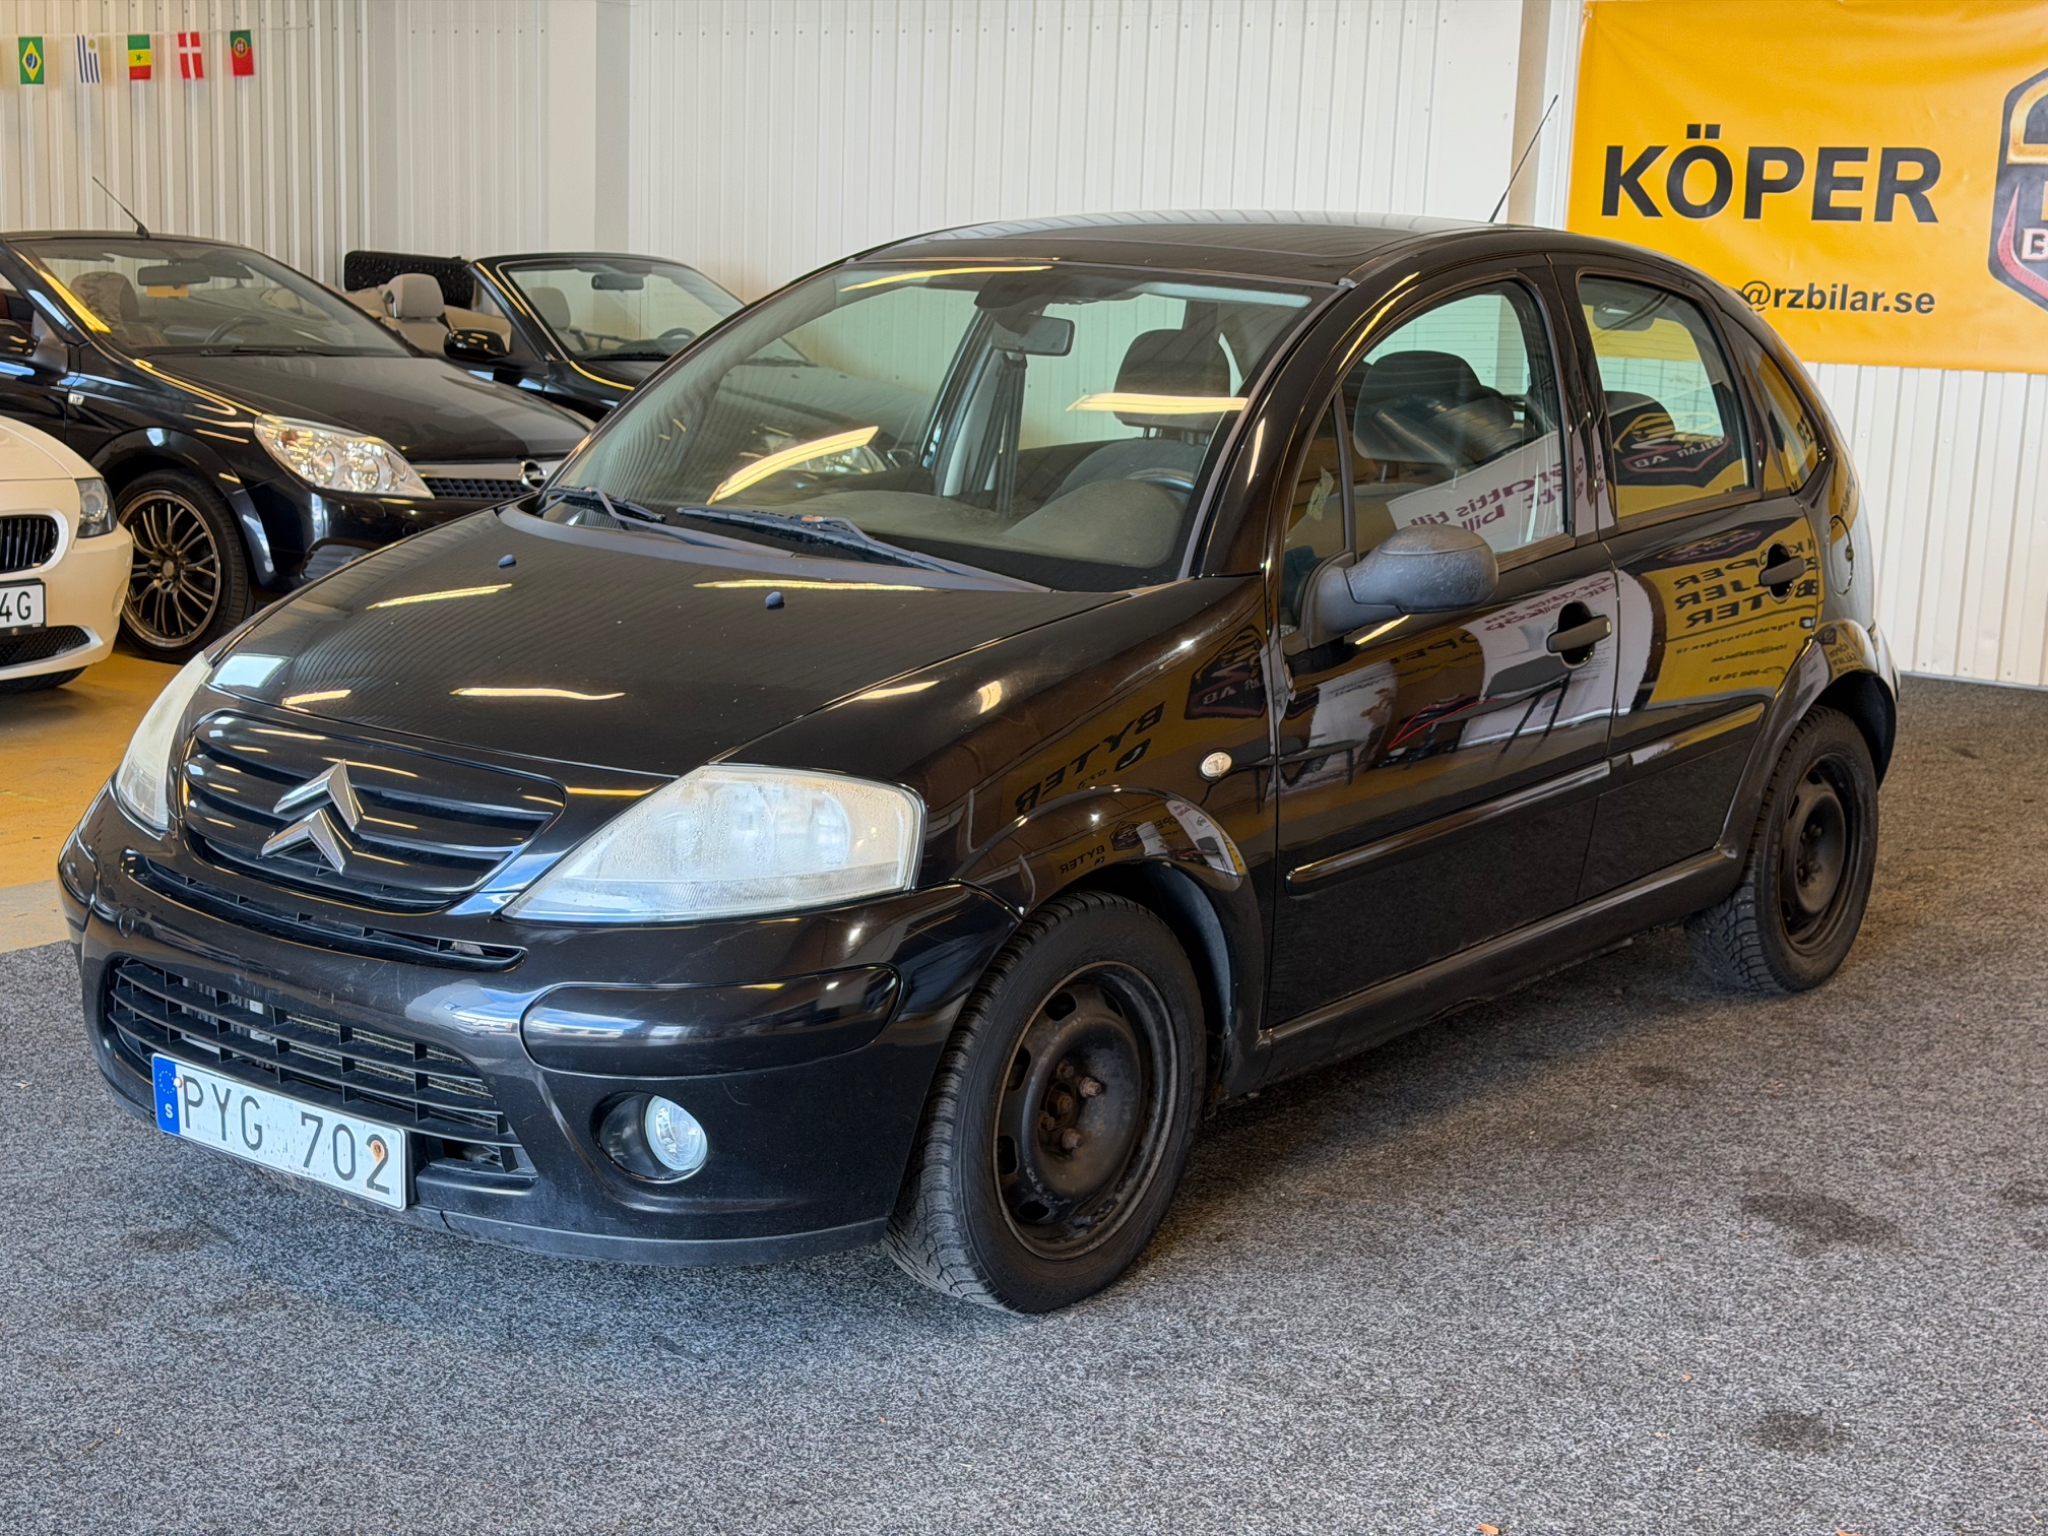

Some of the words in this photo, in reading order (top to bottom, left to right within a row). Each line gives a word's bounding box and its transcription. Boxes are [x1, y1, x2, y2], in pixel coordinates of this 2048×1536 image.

[1601, 124, 1942, 223] KÖPER
[164, 1103, 174, 1119] S
[182, 1074, 263, 1151] PYG
[301, 1111, 390, 1195] 702
